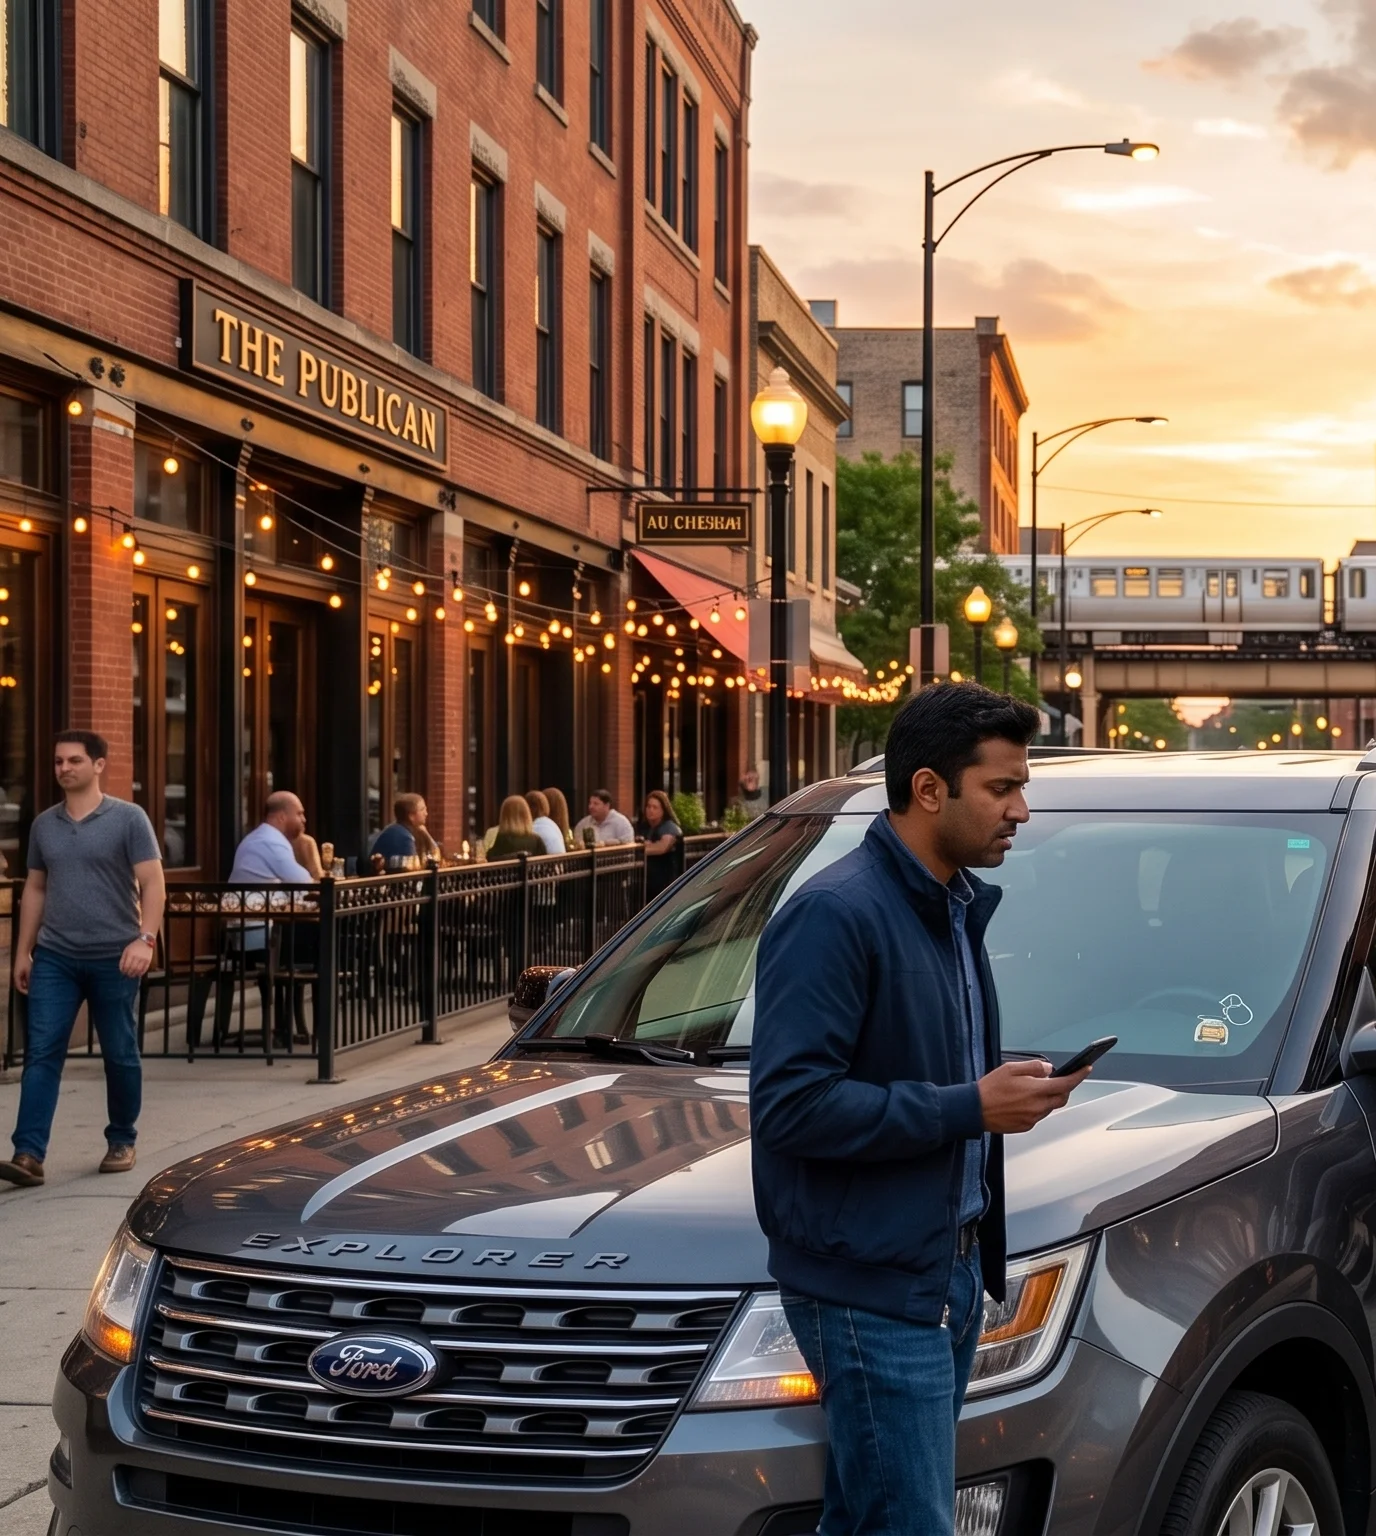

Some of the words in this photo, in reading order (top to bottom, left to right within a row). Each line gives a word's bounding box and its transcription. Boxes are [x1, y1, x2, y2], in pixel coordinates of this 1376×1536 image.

[215, 308, 285, 387] THE
[298, 349, 436, 453] PUBLICAN
[647, 515, 669, 530] AU
[241, 1232, 630, 1270] EXPLORER
[329, 1344, 403, 1381] Ford
